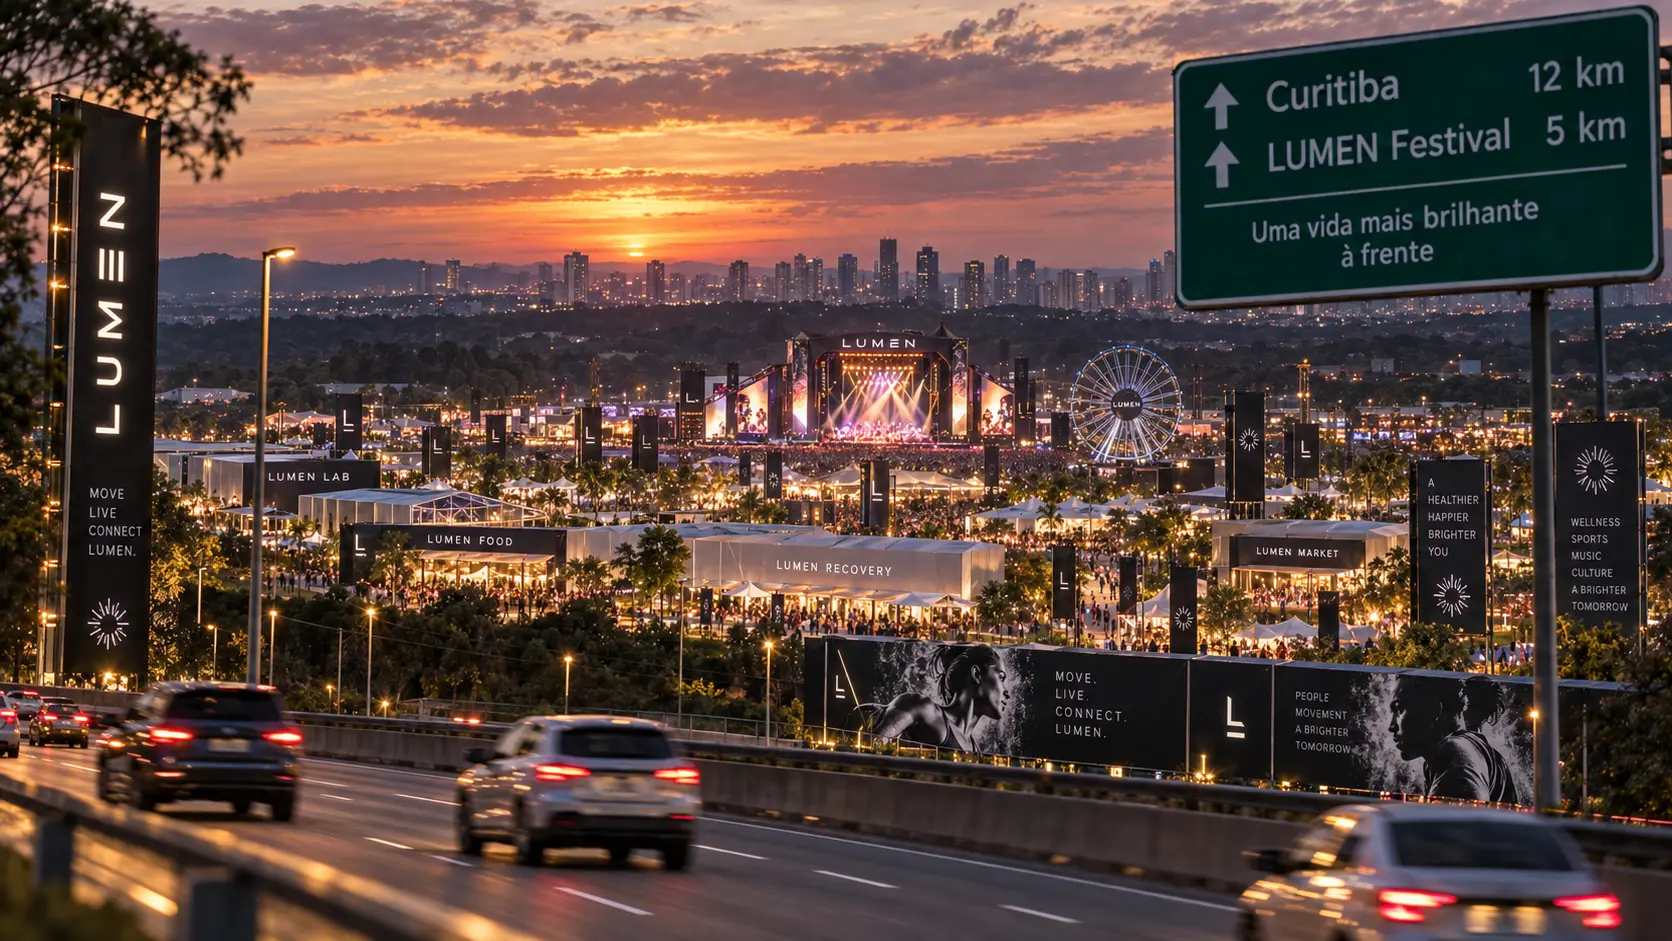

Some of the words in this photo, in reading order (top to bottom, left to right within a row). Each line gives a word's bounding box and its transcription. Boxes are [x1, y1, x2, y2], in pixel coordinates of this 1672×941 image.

[1266, 70, 1400, 113] Curitiba
[1528, 60, 1562, 93] 12
[1576, 56, 1624, 89] km
[1268, 132, 1378, 172] LUMEN
[1392, 117, 1510, 161] Festival
[1546, 114, 1564, 146] 5
[1579, 112, 1626, 143] km
[1252, 220, 1300, 243] Uma
[1307, 213, 1352, 238] vida
[1360, 208, 1413, 234] mais
[1423, 199, 1539, 229] brilhante
[1341, 244, 1354, 268] à
[1360, 240, 1434, 266] frente
[95, 191, 126, 435] LUMEN
[842, 338, 917, 349] LUMEN
[1112, 400, 1141, 409] LUMEN
[268, 471, 316, 482] LUMEN
[323, 471, 350, 482] LAB
[1428, 478, 1435, 488] A
[90, 487, 125, 500] MOVE
[1428, 495, 1479, 505] HEALTHIER
[89, 506, 117, 519] LIVE
[1428, 512, 1469, 522] HAPPIER
[1570, 517, 1620, 527] WELLNESS
[88, 524, 142, 538] CONNECT
[1428, 529, 1476, 540] BRIGHTER
[427, 534, 471, 545] LUMEN
[479, 536, 513, 547] FOOD
[1571, 534, 1608, 544] SPORTS
[88, 543, 137, 557] LUMEN.
[1256, 547, 1292, 557] LUMEN
[1297, 548, 1339, 558] MARKET
[1428, 547, 1449, 557] YOU
[1571, 551, 1602, 561] MUSIC
[776, 560, 819, 572] LUMEN
[825, 562, 892, 577] RECOVERY
[1571, 568, 1613, 578] CULTURE
[1571, 585, 1578, 594] A
[1580, 585, 1627, 595] BRIGHTER
[1571, 601, 1629, 612] TOMORROW
[1055, 671, 1097, 684] MOVE.
[1055, 688, 1089, 702] LIVE.
[1295, 691, 1329, 703] PEOPLE
[1055, 706, 1127, 723] CONNECT.
[1295, 708, 1348, 720] MOVEMENT
[1055, 724, 1107, 739] LUMEN.
[1295, 724, 1302, 735] A
[1304, 724, 1349, 737] BRIGHTER
[1295, 740, 1351, 754] TOMORROW
